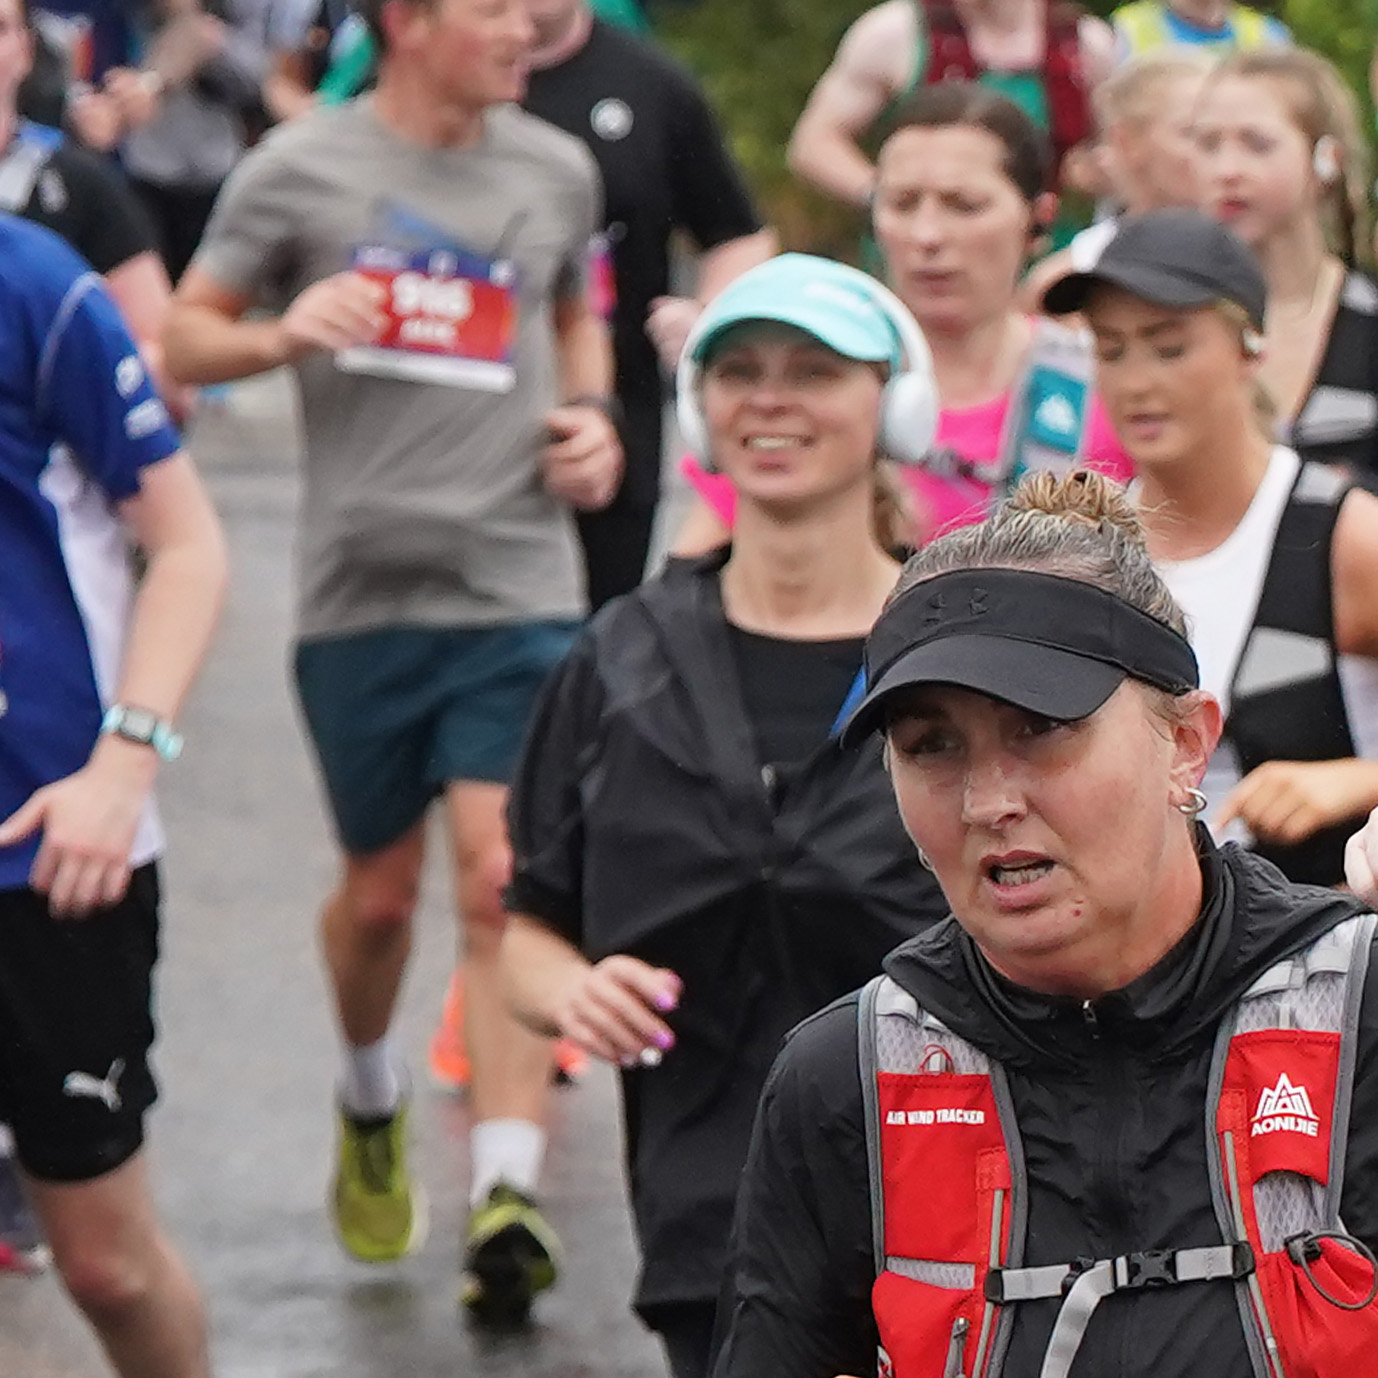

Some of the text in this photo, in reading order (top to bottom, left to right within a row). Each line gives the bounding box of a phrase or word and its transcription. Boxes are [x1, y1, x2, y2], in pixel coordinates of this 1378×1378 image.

[886, 1110, 906, 1125] AIR
[936, 1108, 985, 1124] TRACKER
[1250, 1116, 1319, 1138] AONIJIE
